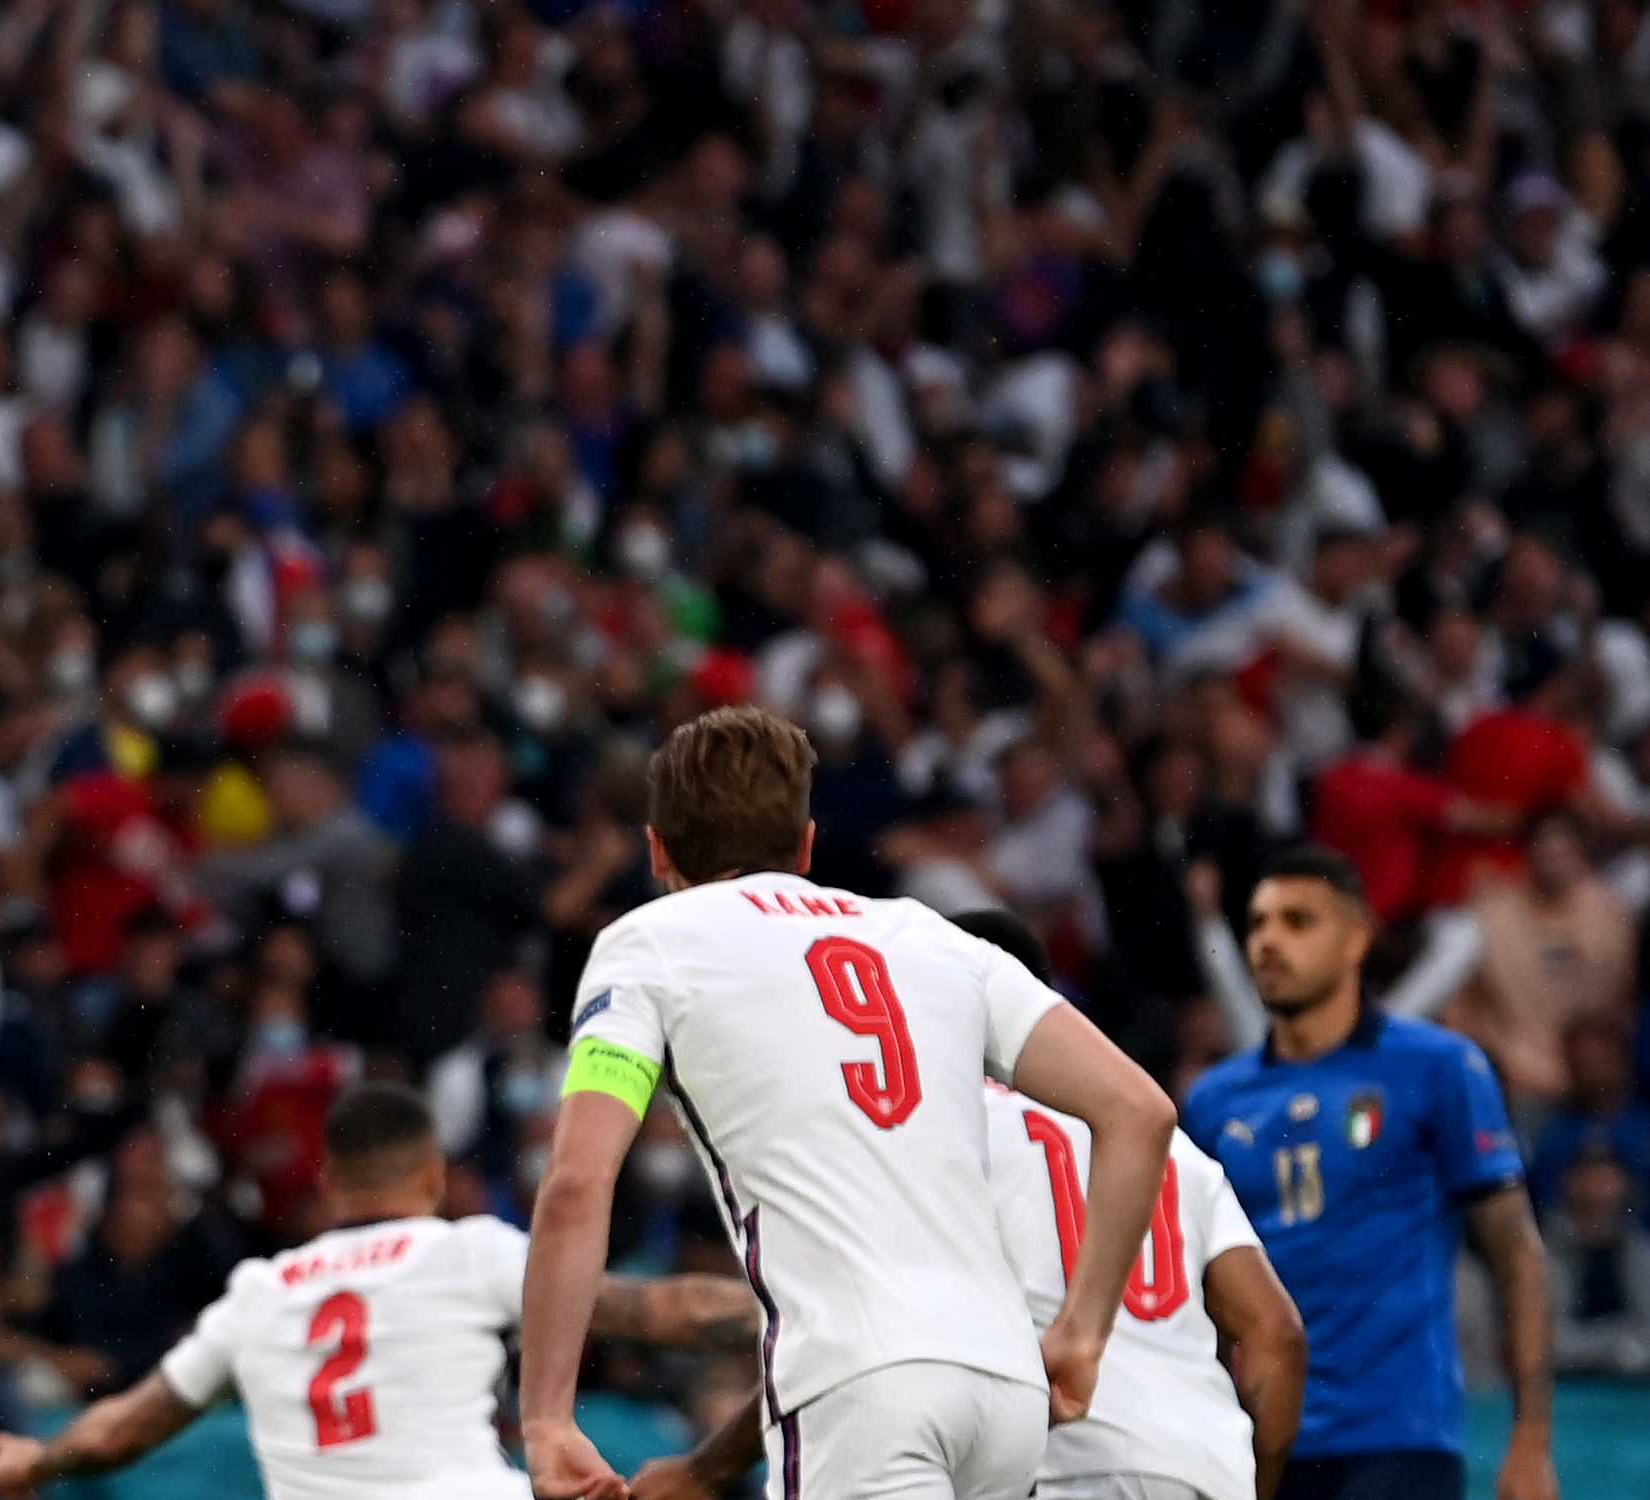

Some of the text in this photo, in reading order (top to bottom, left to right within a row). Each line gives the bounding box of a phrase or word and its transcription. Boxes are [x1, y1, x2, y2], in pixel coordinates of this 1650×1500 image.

[805, 936, 922, 1129] 9
[1023, 1110, 1190, 1321] 10
[308, 1291, 377, 1450] 2
